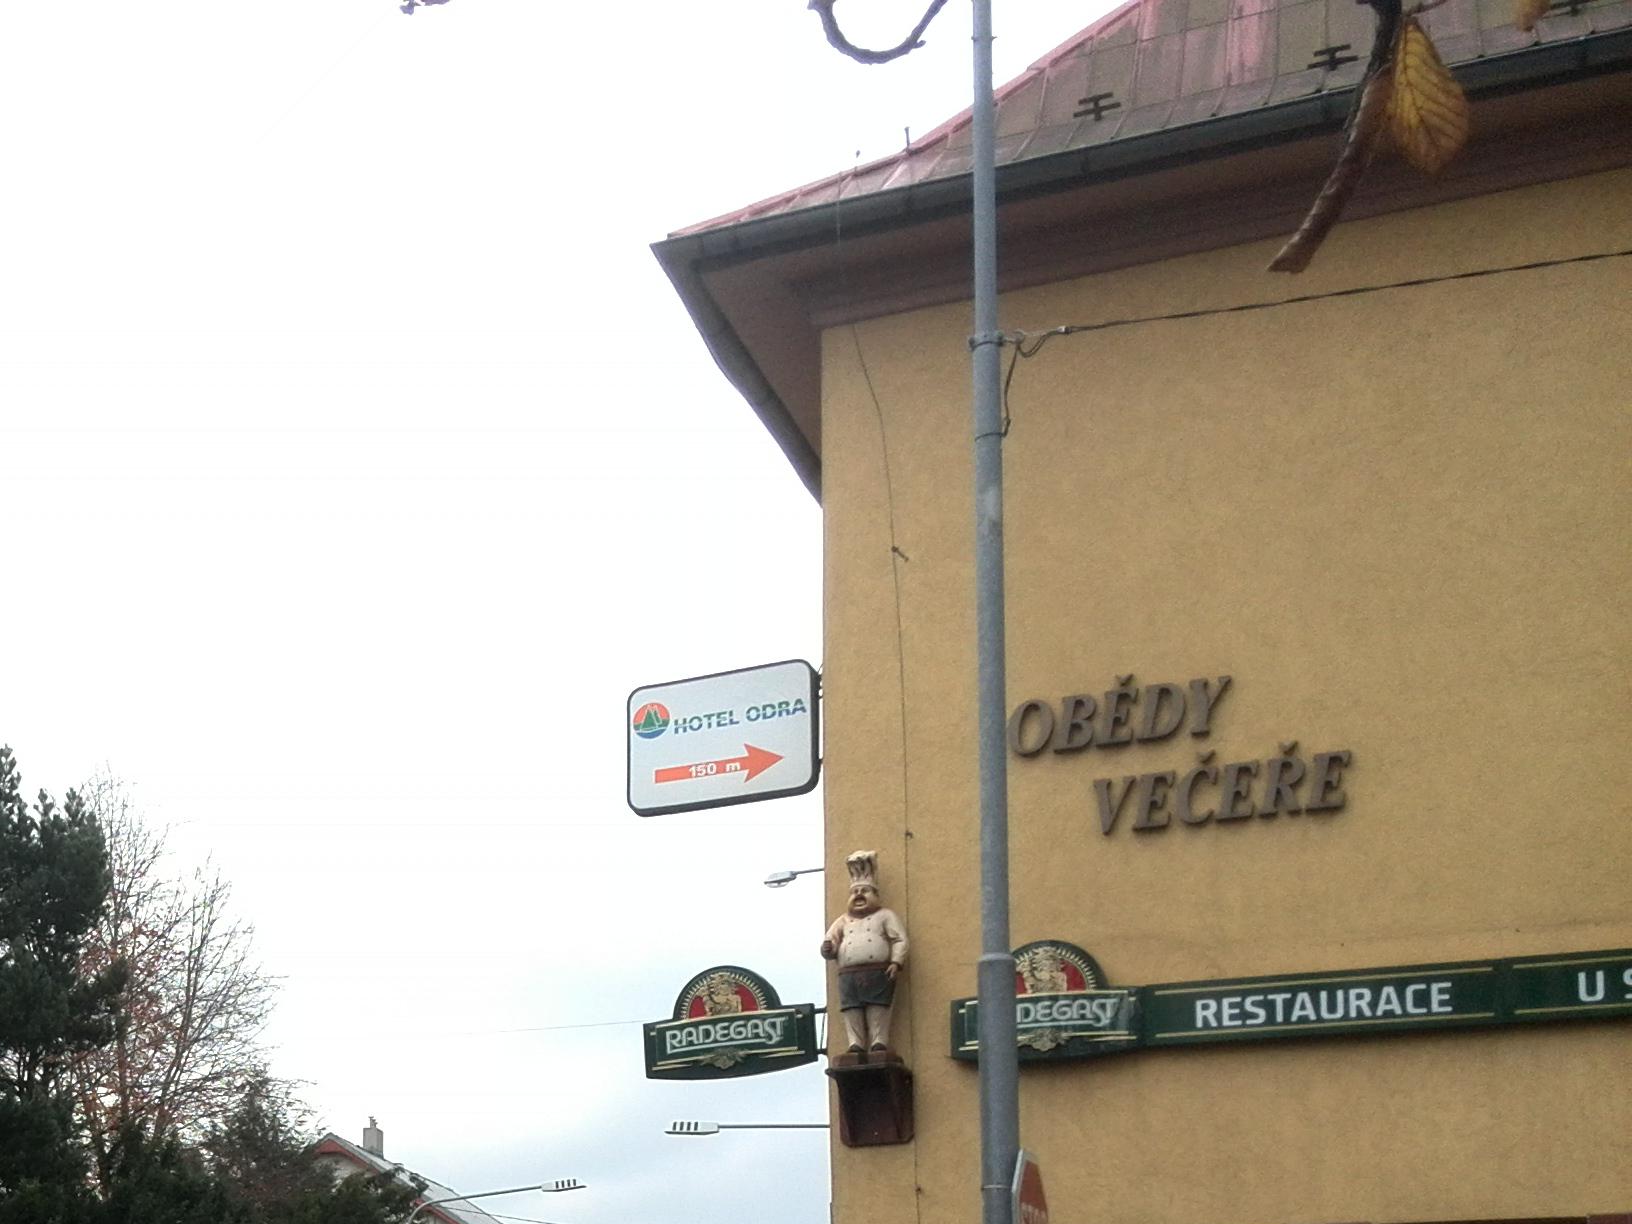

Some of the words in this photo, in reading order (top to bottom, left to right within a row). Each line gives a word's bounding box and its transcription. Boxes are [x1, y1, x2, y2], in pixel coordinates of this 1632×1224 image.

[673, 710, 739, 735] HOTEL
[746, 698, 807, 723] ODRA
[1007, 673, 1232, 758] OBĚDY
[688, 763, 717, 778] 150
[725, 761, 741, 774] m
[1093, 740, 1352, 836] VEČEŘE
[1195, 981, 1453, 1029] RESTAURACE
[1577, 970, 1605, 1002] U
[1017, 997, 1119, 1028] DEGAST
[665, 1015, 788, 1054] RADEGAST
